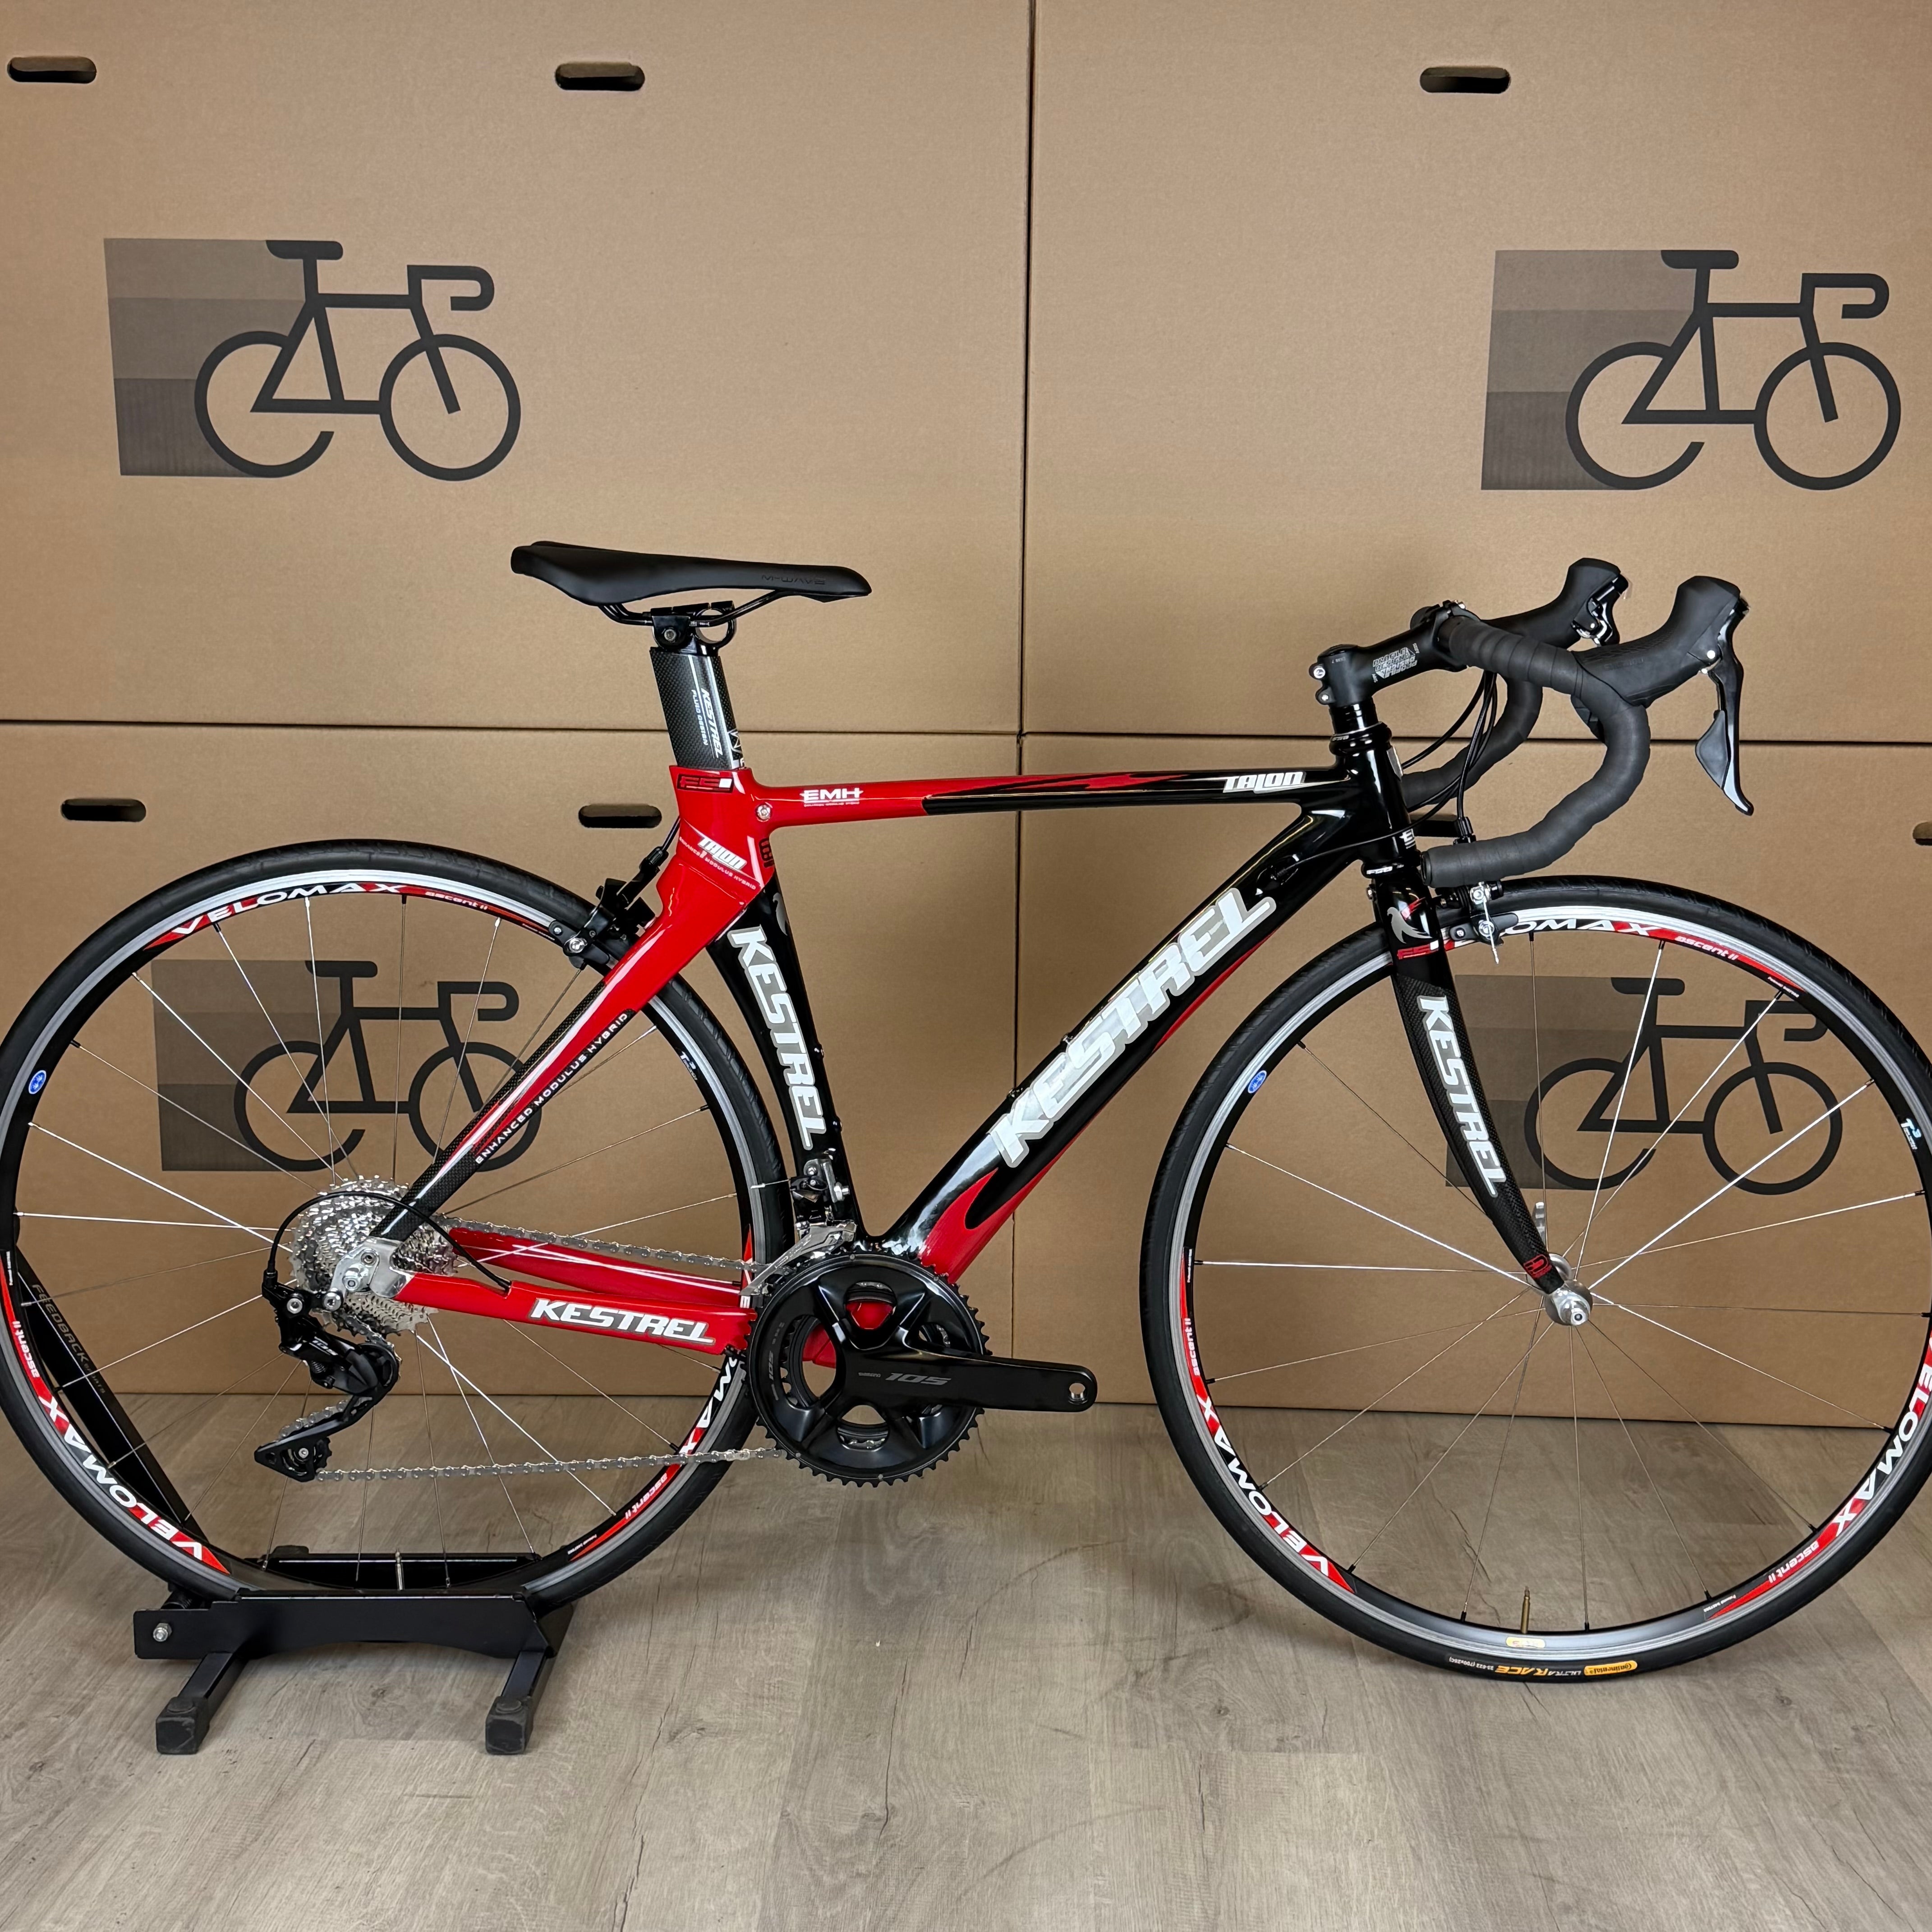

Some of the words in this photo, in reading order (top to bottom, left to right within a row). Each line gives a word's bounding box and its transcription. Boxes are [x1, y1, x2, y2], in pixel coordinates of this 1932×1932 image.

[700, 688, 723, 759] KESTREL
[800, 787, 864, 801] EMH
[1223, 771, 1306, 794] TALON
[697, 837, 747, 870] TALON
[704, 856, 733, 877] MODULUS
[734, 874, 757, 890] HYBRID
[172, 883, 403, 934] VELOMAX
[425, 891, 479, 908] ascent
[1674, 936, 1729, 957] ascent
[727, 925, 826, 1150] KESTREL
[988, 888, 1276, 1168] KESTREL
[475, 1107, 533, 1164] ENHANCED
[534, 1053, 587, 1106] MODULUS
[587, 1013, 628, 1053] HYBRID
[1417, 995, 1507, 1198] KESTREL
[32, 1283, 90, 1364] FEEDBACK
[529, 1297, 716, 1345] KESTREL
[15, 1329, 41, 1378] ascent
[1185, 1327, 1201, 1376] ascent
[885, 1373, 952, 1385] 105
[38, 1396, 203, 1560] VELOMAX
[632, 1473, 668, 1514] ascent
[1196, 1394, 1329, 1578] VELOMAX
[1776, 1541, 1820, 1578] ascent
[1593, 1663, 1632, 1674] Continental
